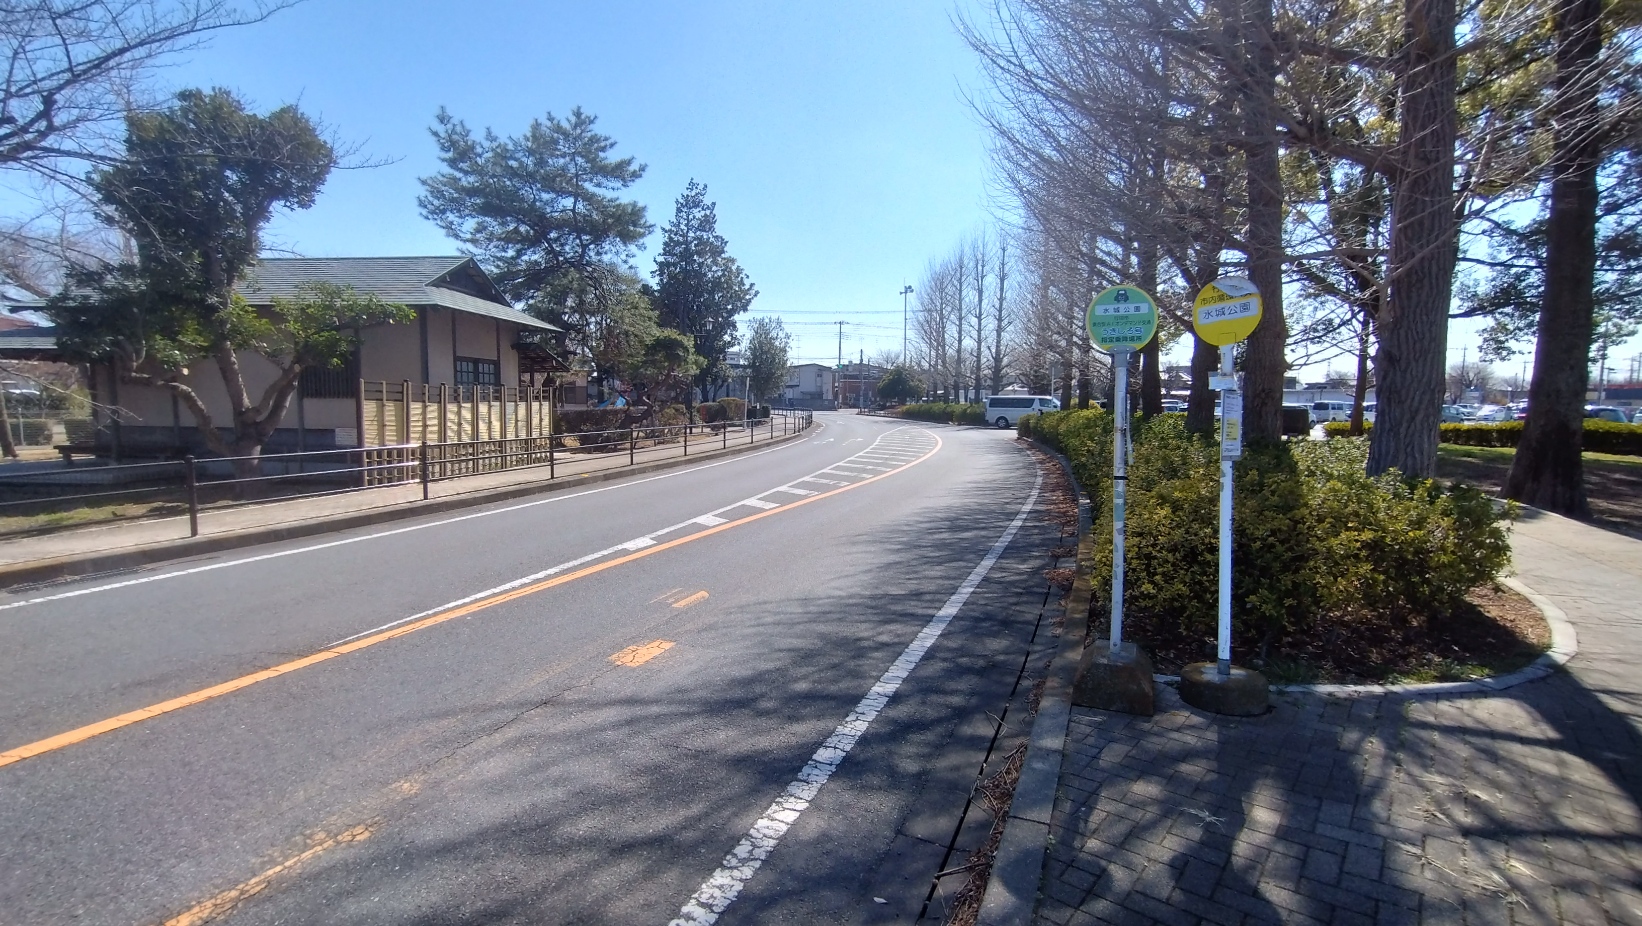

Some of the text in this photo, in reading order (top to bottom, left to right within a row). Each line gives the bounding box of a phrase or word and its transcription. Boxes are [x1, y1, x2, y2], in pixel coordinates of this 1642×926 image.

[1102, 305, 1141, 314] 水城公園
[1203, 301, 1251, 320] 水城公園
[1102, 326, 1143, 336] うきしろ号
